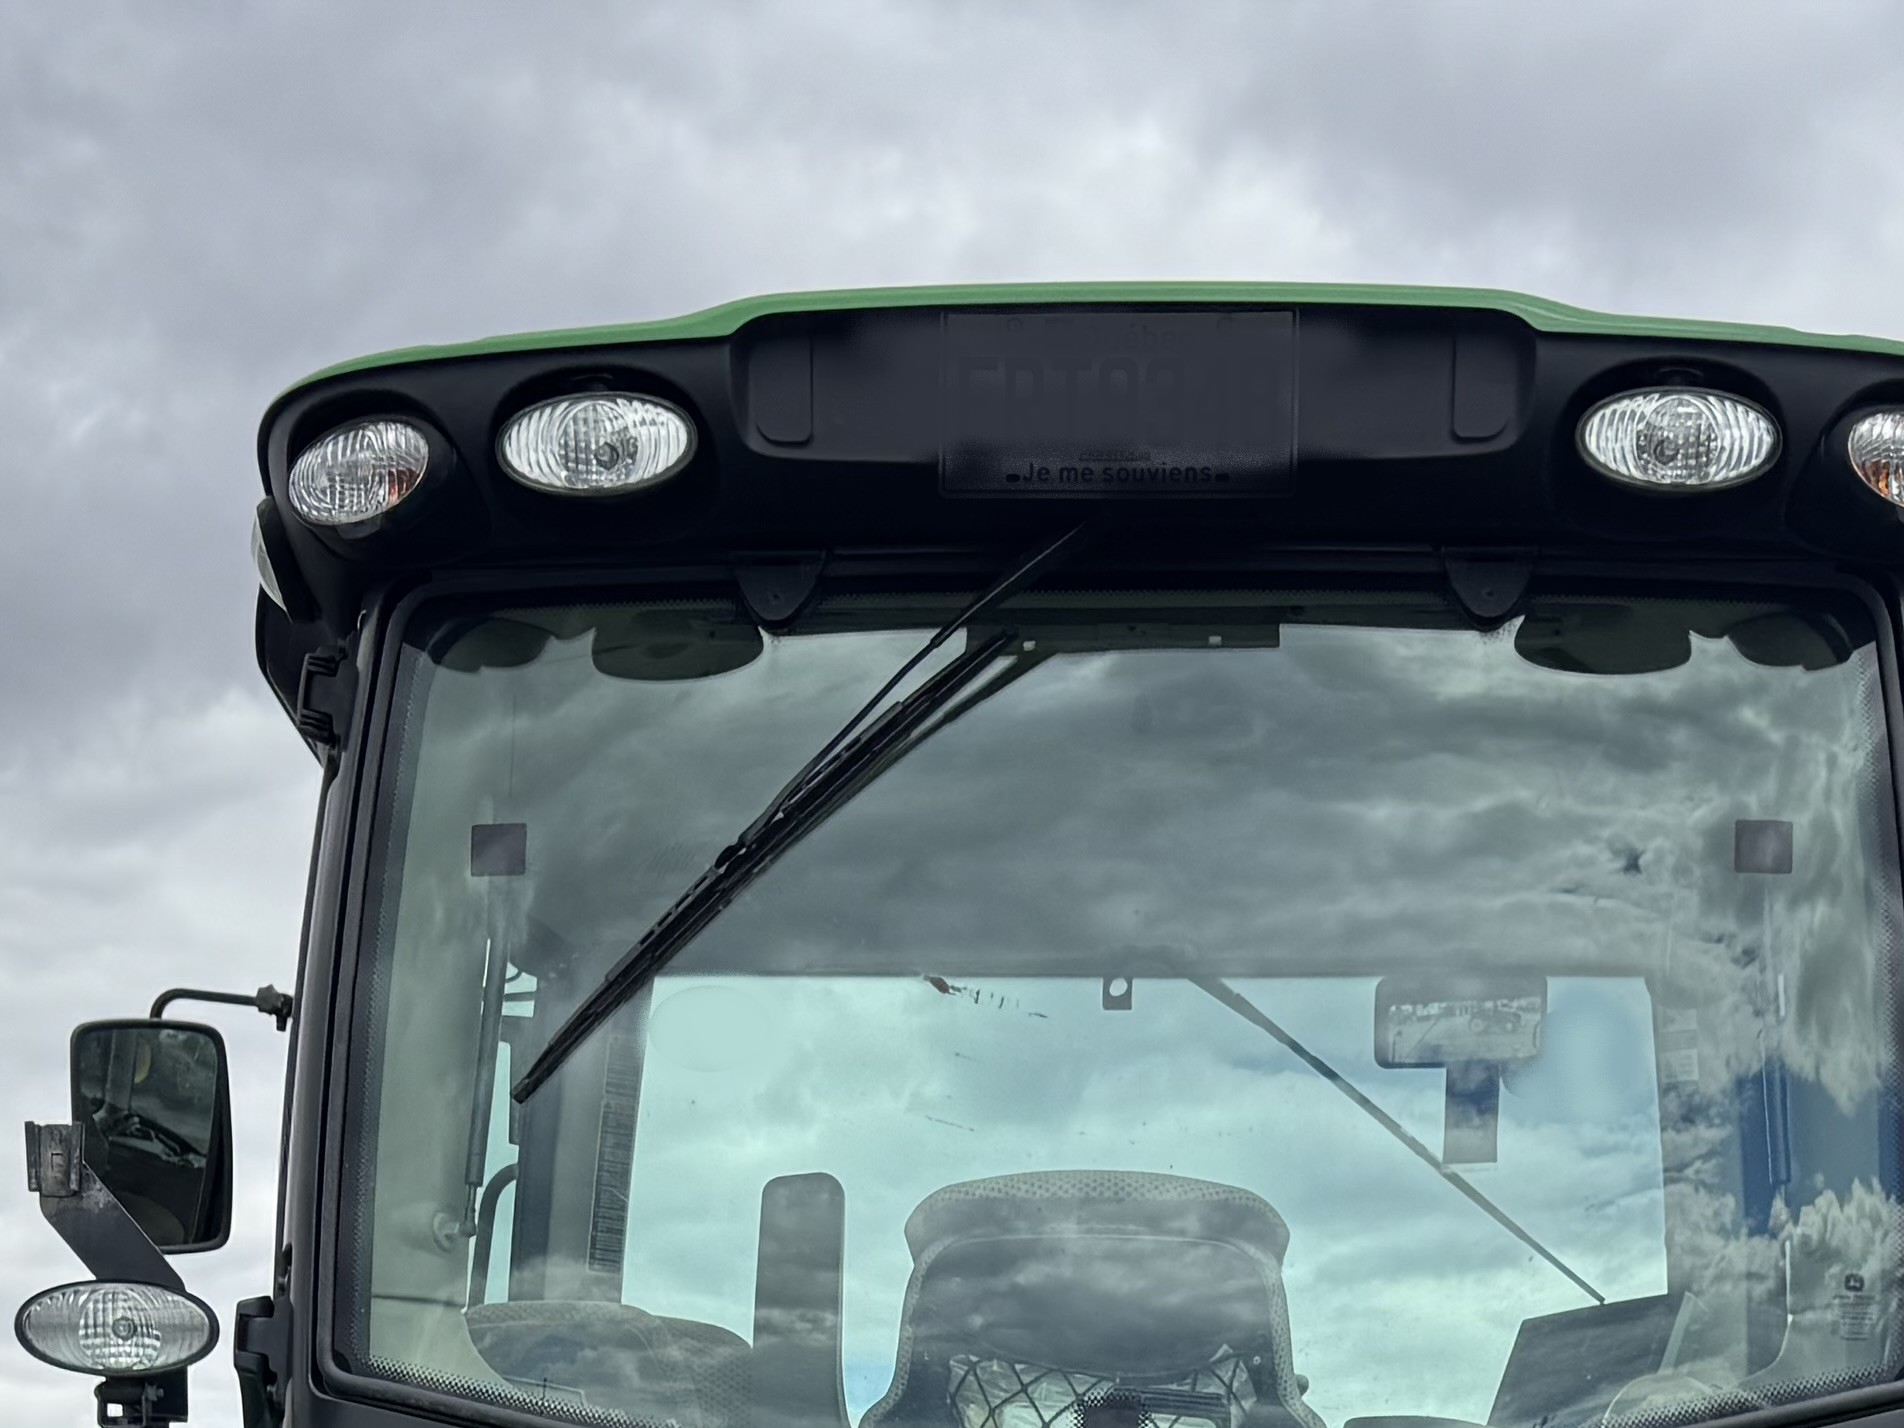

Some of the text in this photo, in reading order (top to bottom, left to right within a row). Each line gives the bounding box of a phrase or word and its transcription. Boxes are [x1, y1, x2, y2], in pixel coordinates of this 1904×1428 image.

[1023, 462, 1212, 483] Je me souviens
